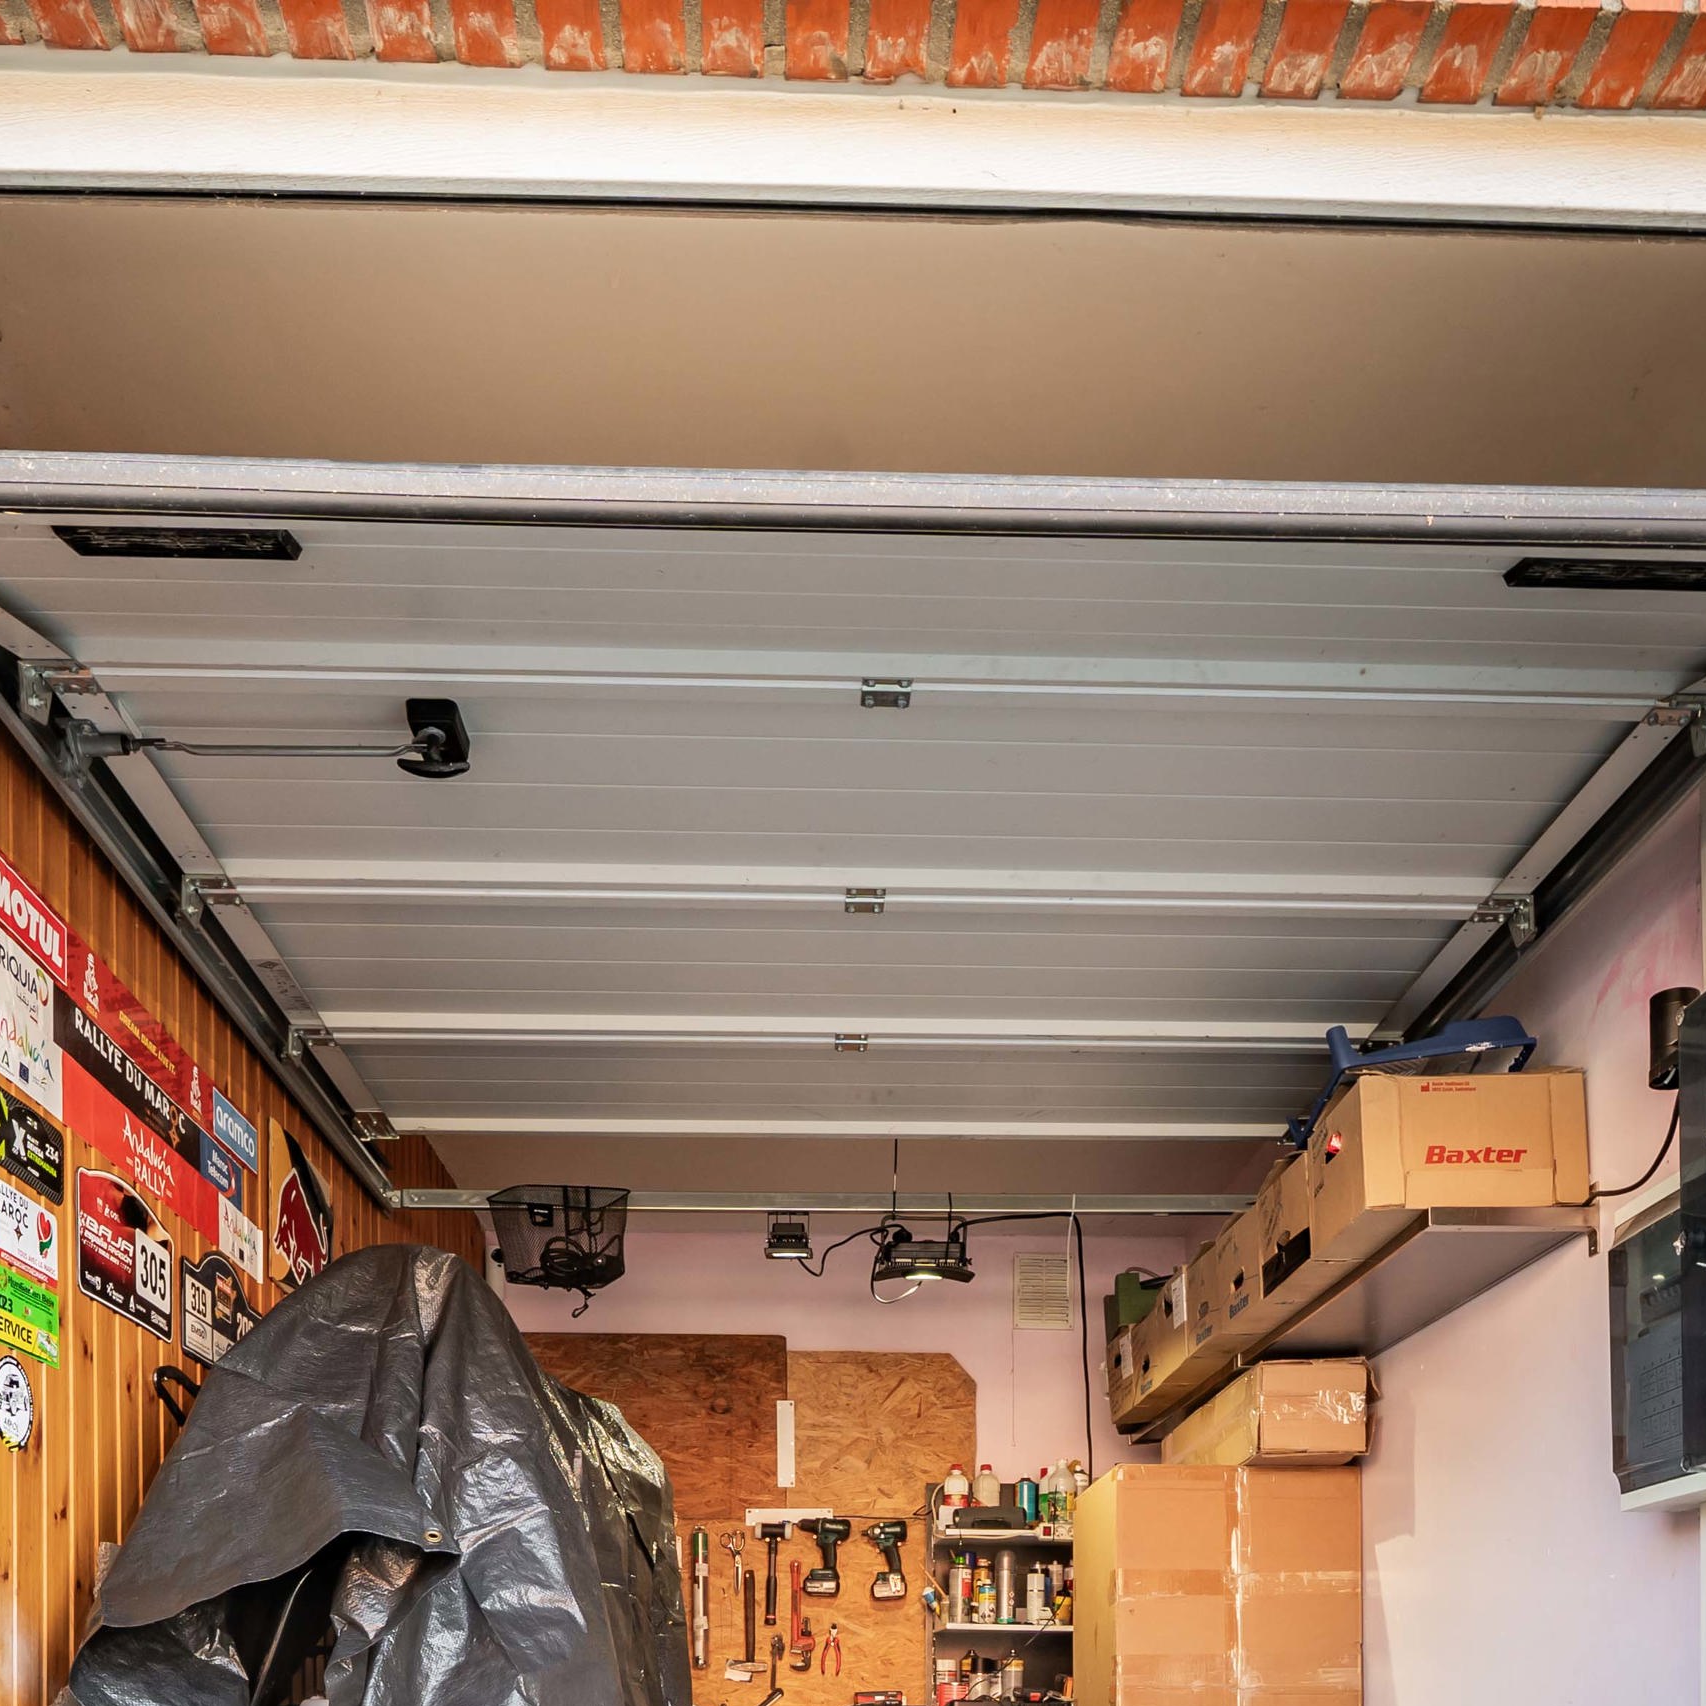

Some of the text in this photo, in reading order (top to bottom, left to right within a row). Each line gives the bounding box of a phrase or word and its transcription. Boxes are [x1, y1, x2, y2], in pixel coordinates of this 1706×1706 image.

[75, 1007, 186, 1135] RALLYE DU MAROC
[216, 1106, 255, 1158] aramco
[44, 1143, 60, 1164] 234
[212, 1150, 229, 1175] Maroc
[1425, 1145, 1528, 1165] Baxter
[134, 1156, 166, 1198] RALLY
[19, 1196, 29, 1210] DU
[86, 1215, 134, 1257] BAJA
[140, 1244, 167, 1302] 305
[190, 1281, 207, 1318] 319
